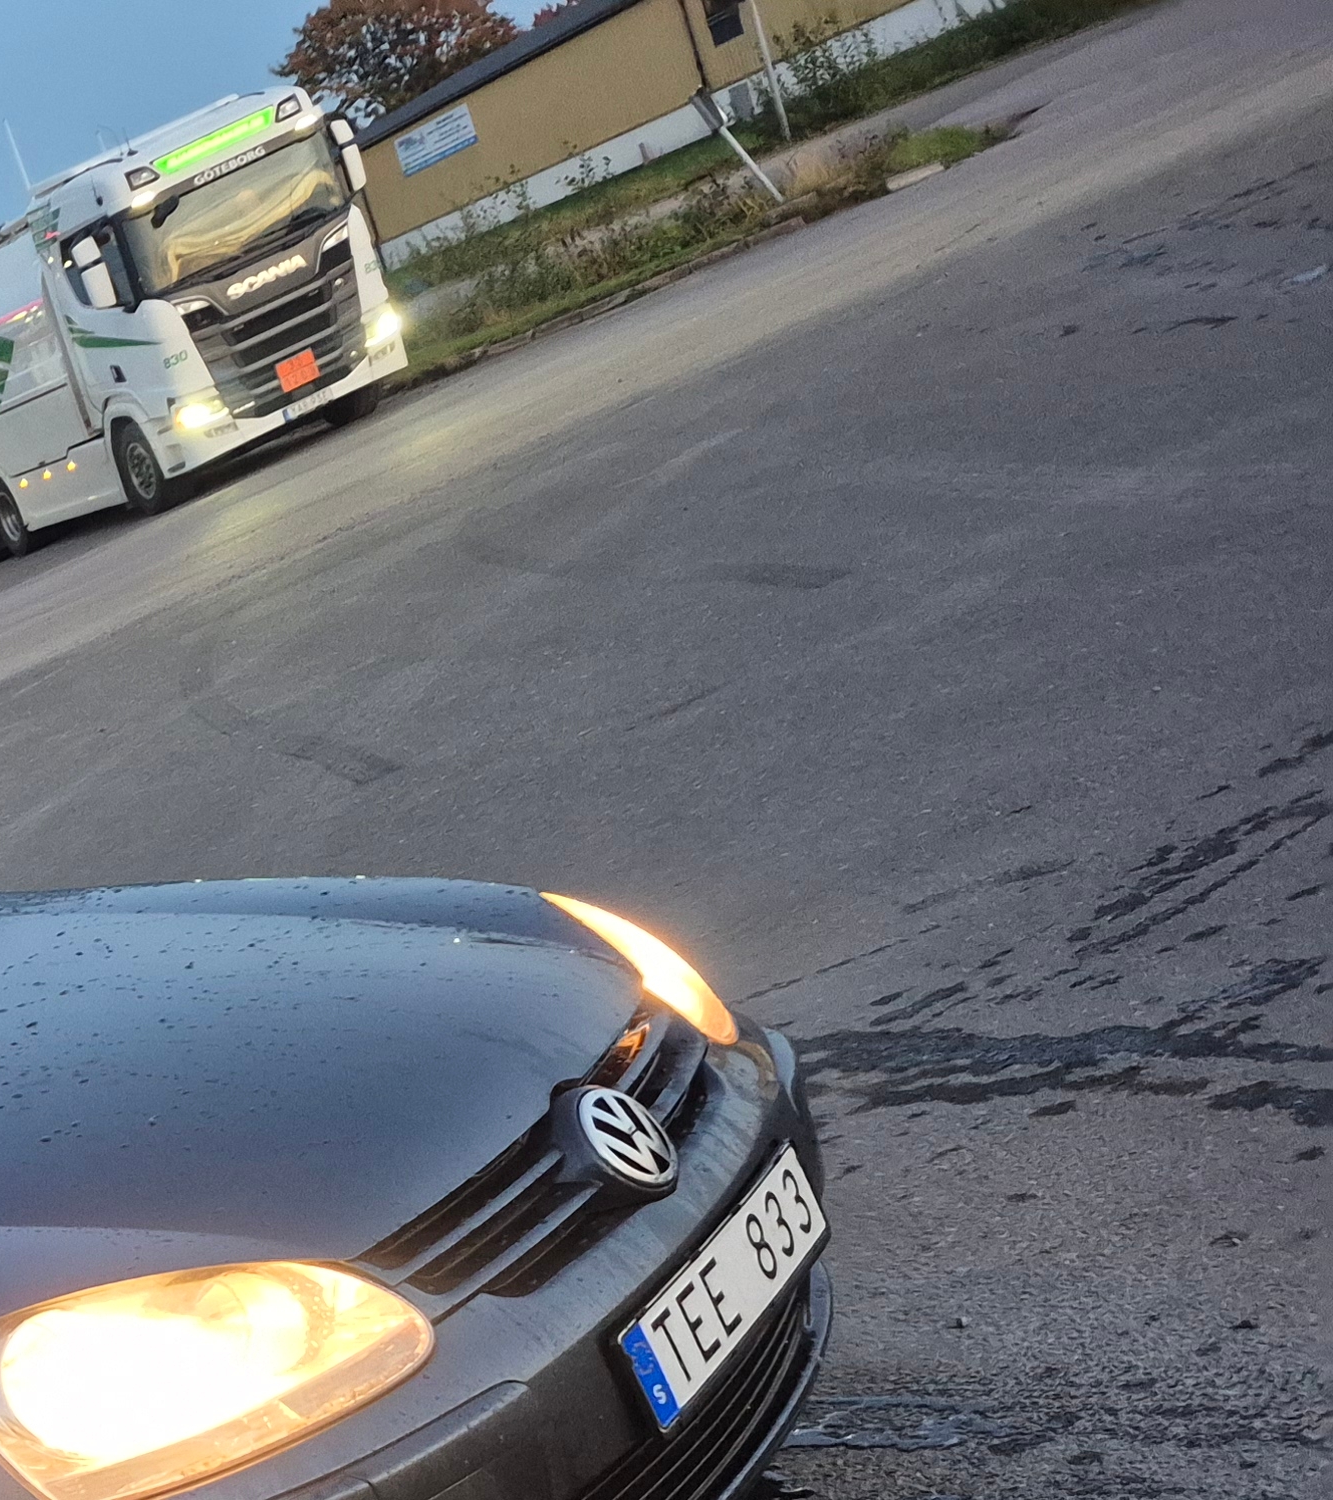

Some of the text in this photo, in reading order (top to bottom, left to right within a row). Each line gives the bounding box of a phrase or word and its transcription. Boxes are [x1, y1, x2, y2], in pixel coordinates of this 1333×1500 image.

[193, 146, 266, 185] GÖTEBORG
[226, 254, 307, 300] SCANIA
[163, 350, 188, 369] 830
[651, 1168, 812, 1383] TEE 833
[652, 1383, 667, 1405] S
